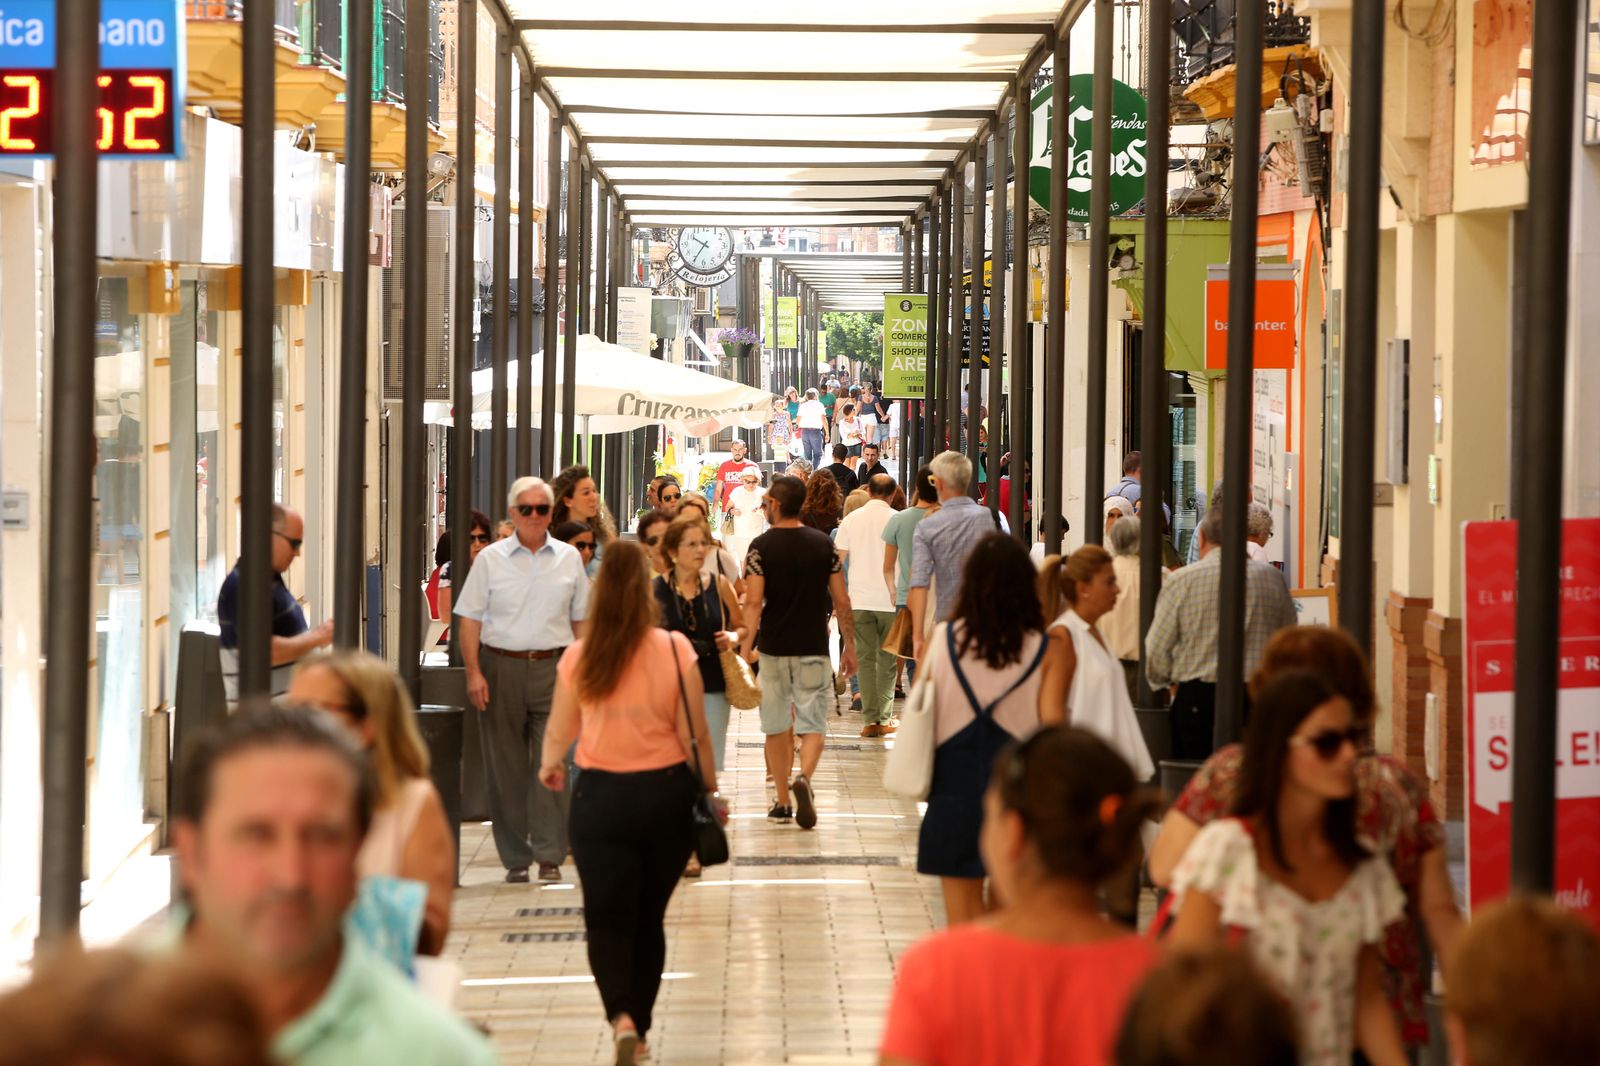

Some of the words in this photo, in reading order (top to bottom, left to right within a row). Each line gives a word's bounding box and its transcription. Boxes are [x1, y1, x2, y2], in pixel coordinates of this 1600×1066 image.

[891, 318, 928, 333] ZON
[891, 332, 928, 341] COMERC
[891, 347, 927, 356] SHOPPI
[890, 356, 927, 372] ARE
